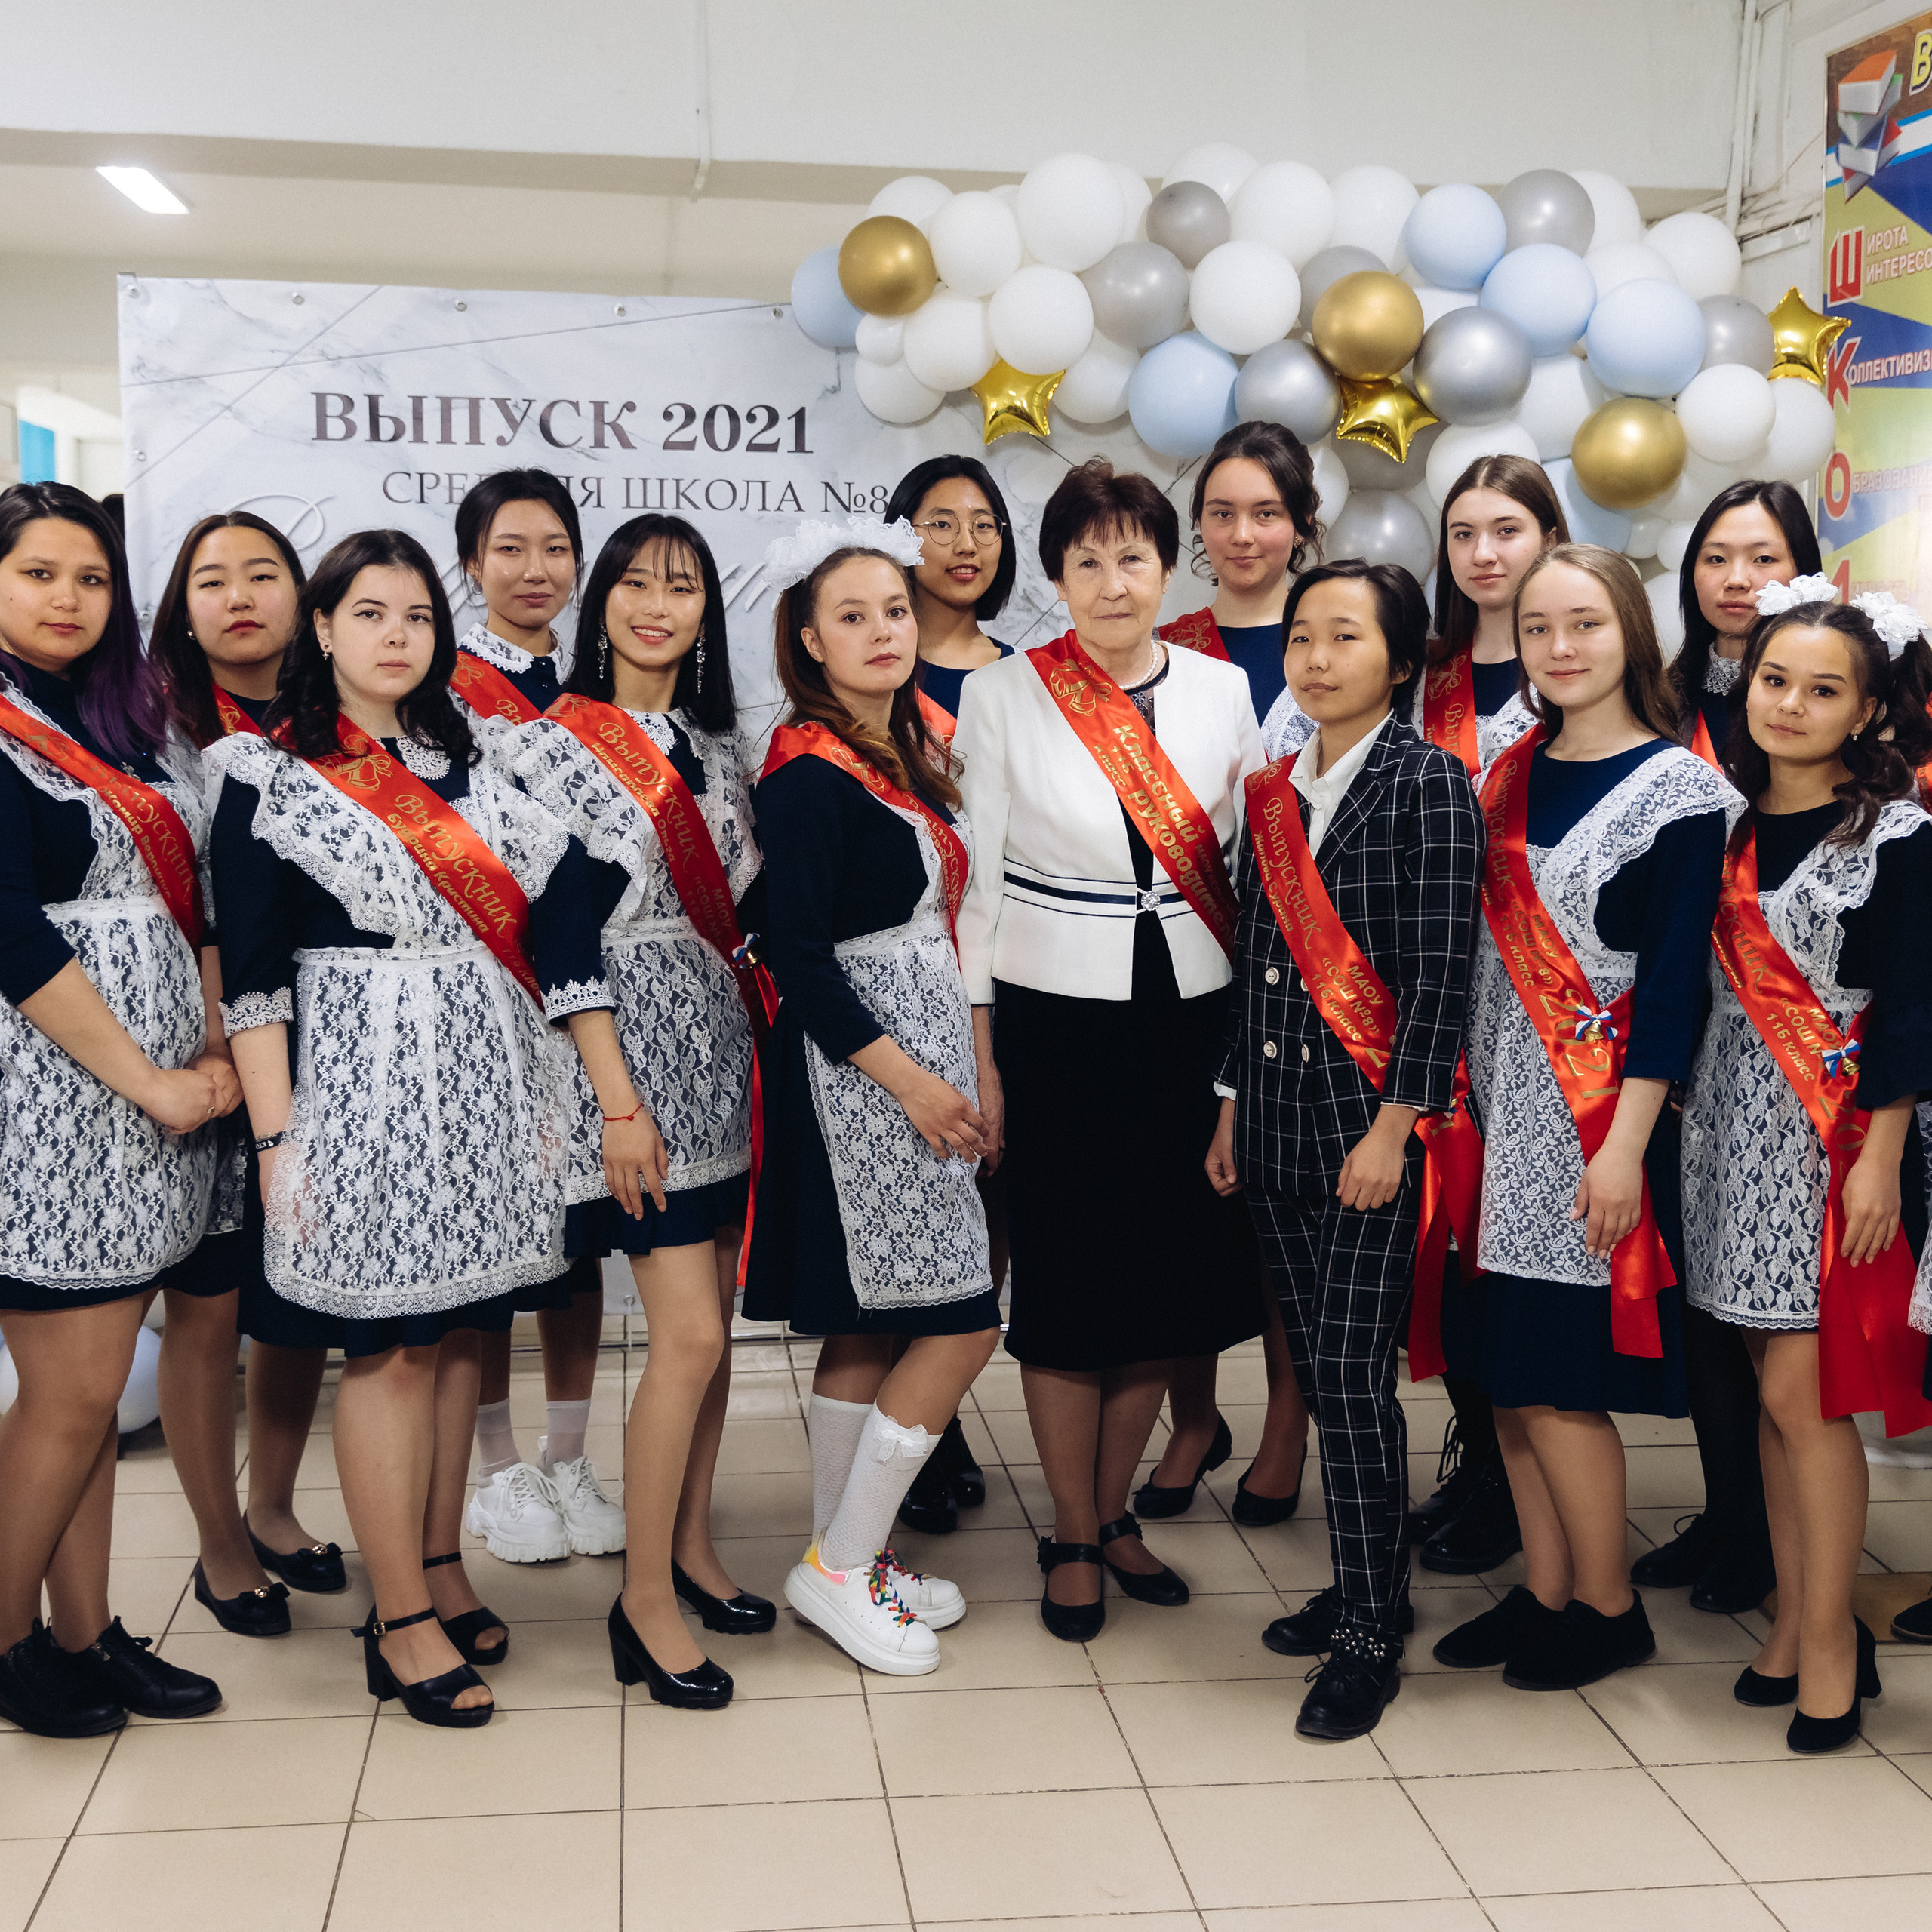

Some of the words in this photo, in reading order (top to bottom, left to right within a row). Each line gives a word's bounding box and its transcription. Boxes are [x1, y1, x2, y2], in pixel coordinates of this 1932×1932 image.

[310, 392, 638, 450] ВЫПУСК
[662, 402, 814, 454] 2021
[383, 471, 606, 509] СРЕЯ
[621, 477, 807, 512] ШКОЛА
[820, 481, 889, 515] №8
[1094, 744, 1127, 787] класс
[1112, 724, 1205, 843] Классный
[597, 721, 700, 873] Выпускник
[393, 794, 517, 938] Выпускник
[1263, 797, 1322, 950] Выпускник
[433, 871, 489, 933] Кристина
[1531, 914, 1561, 958] МАОУ
[1346, 965, 1384, 1004] МАОУ
[1510, 946, 1534, 987] класс
[1327, 1000, 1362, 1041] класс
[1783, 1041, 1816, 1081] класс
